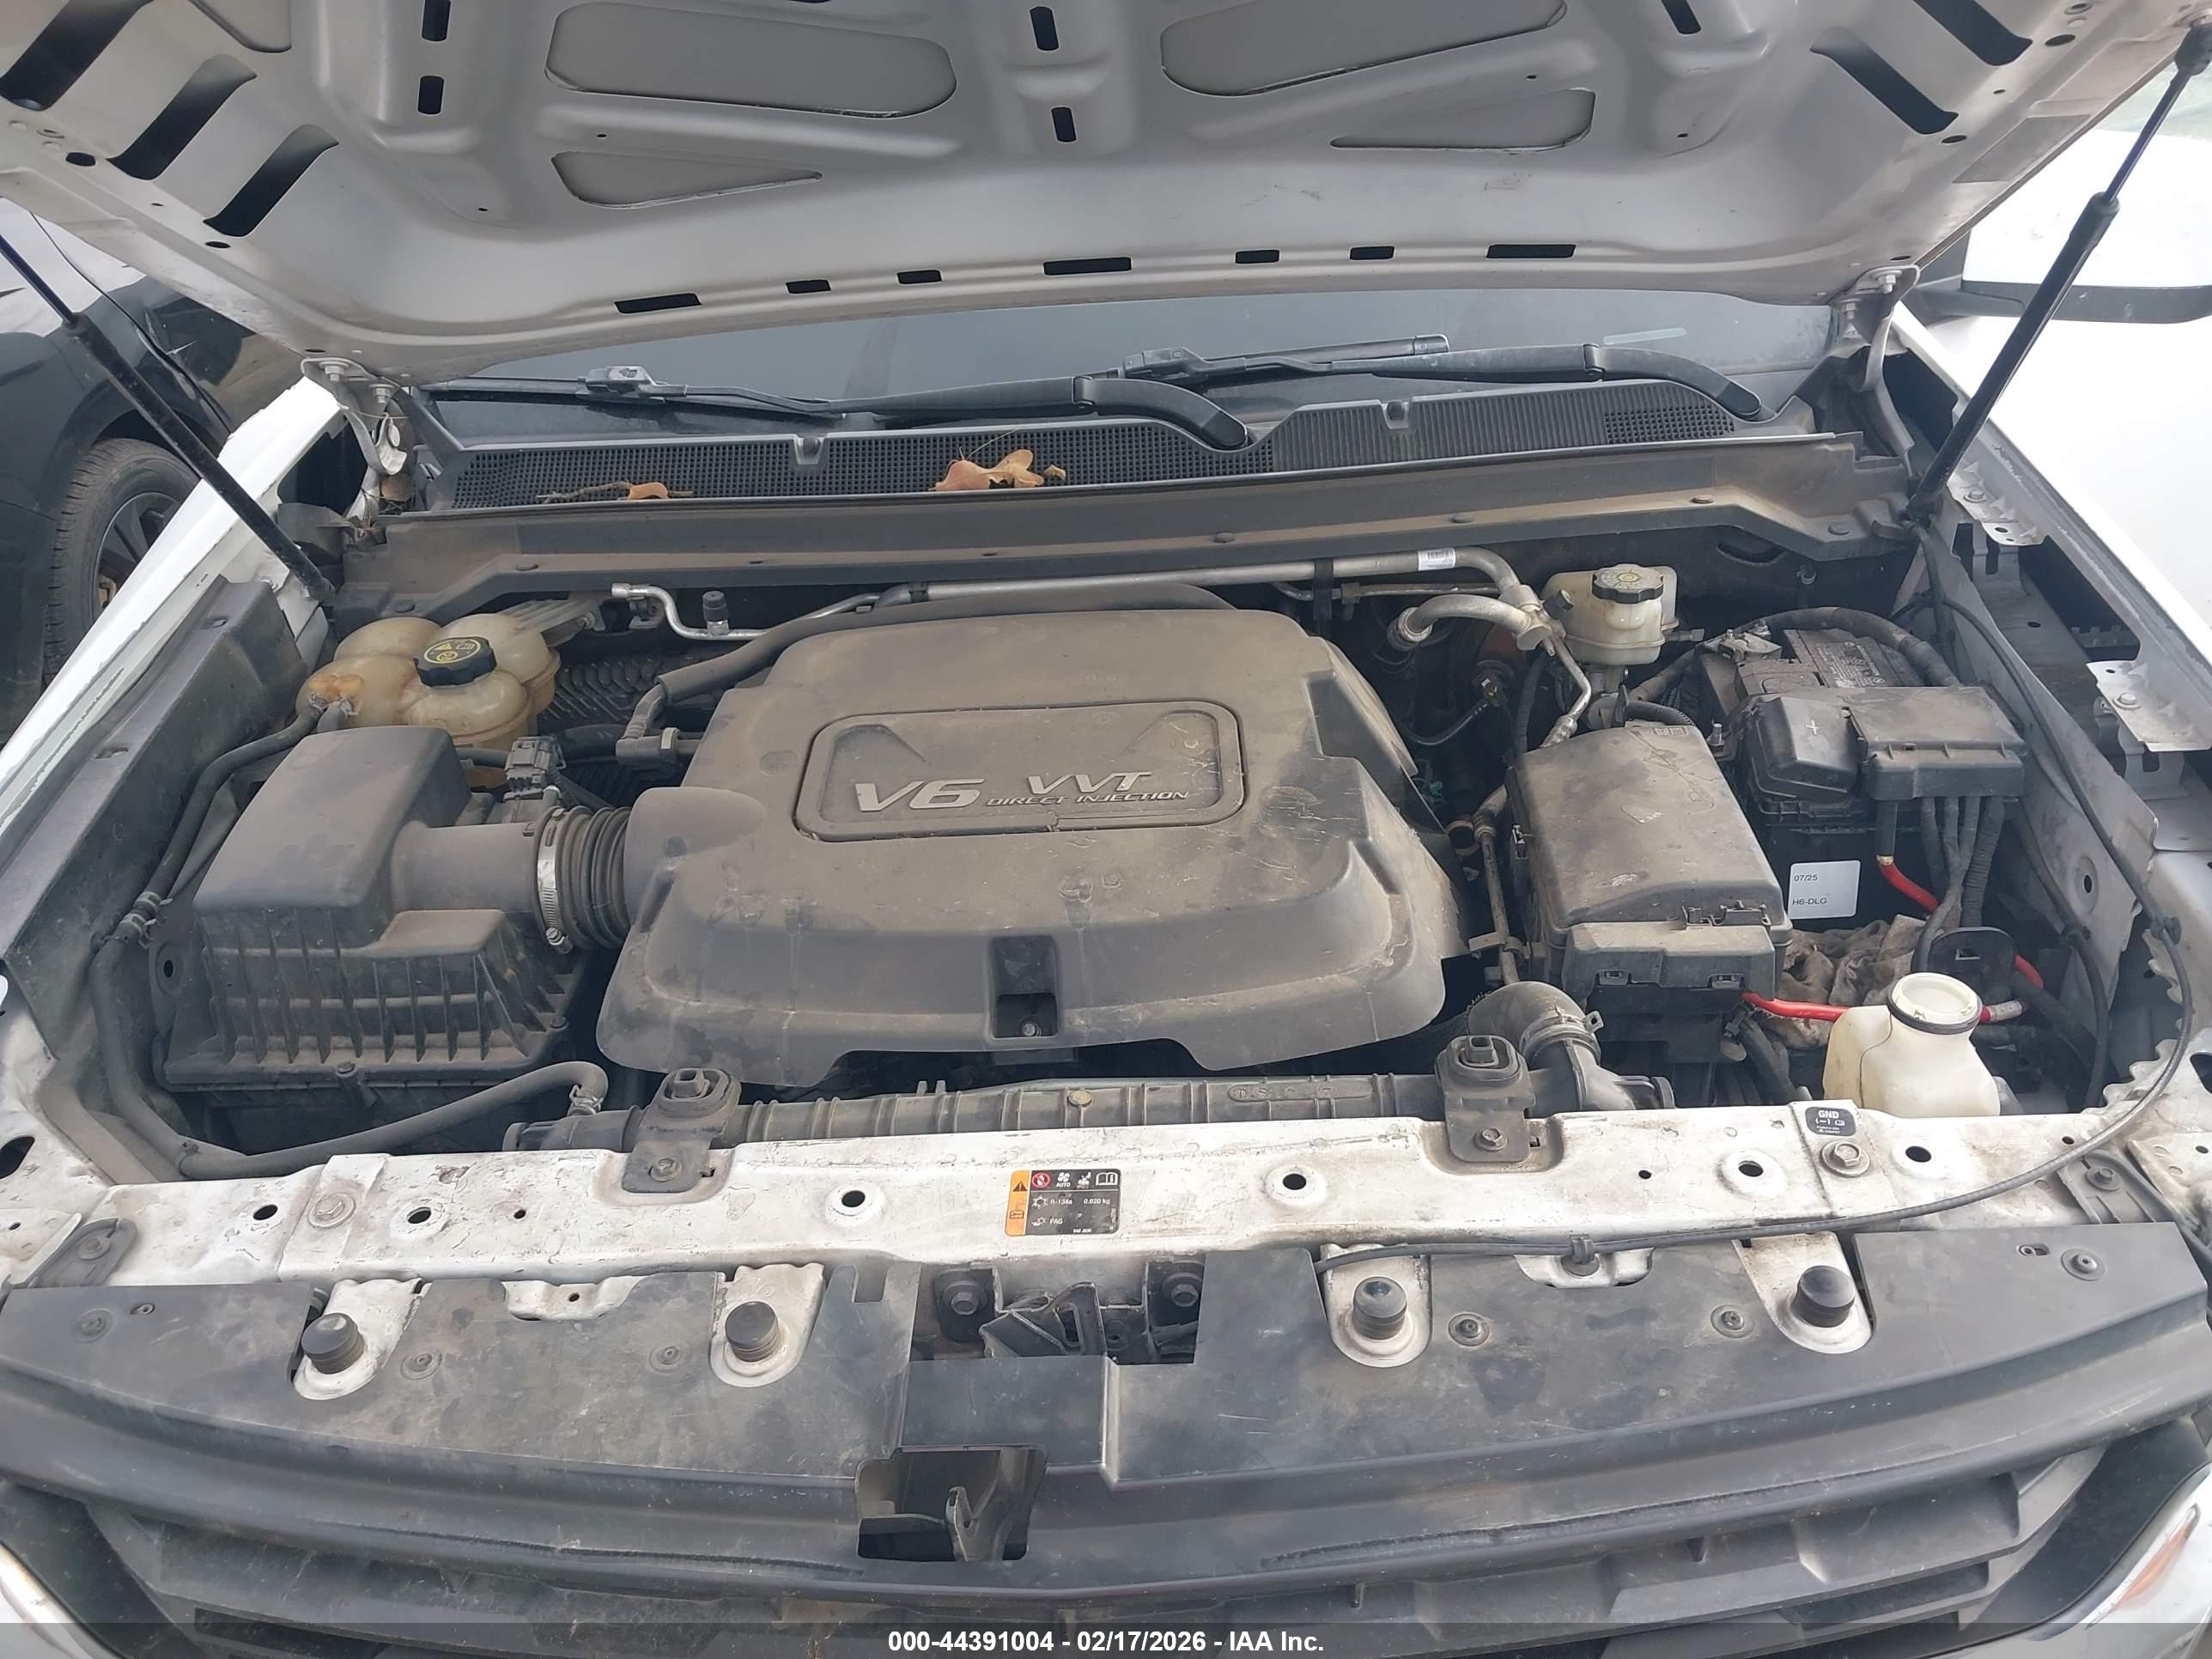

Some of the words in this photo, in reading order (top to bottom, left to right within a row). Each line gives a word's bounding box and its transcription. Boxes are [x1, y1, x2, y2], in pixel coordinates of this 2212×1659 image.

[1026, 771, 1152, 794] VVT
[855, 777, 985, 811] V6
[986, 796, 1068, 807] DIRECT
[1076, 790, 1189, 805] INJECTION
[1818, 1109, 1839, 1119] GND
